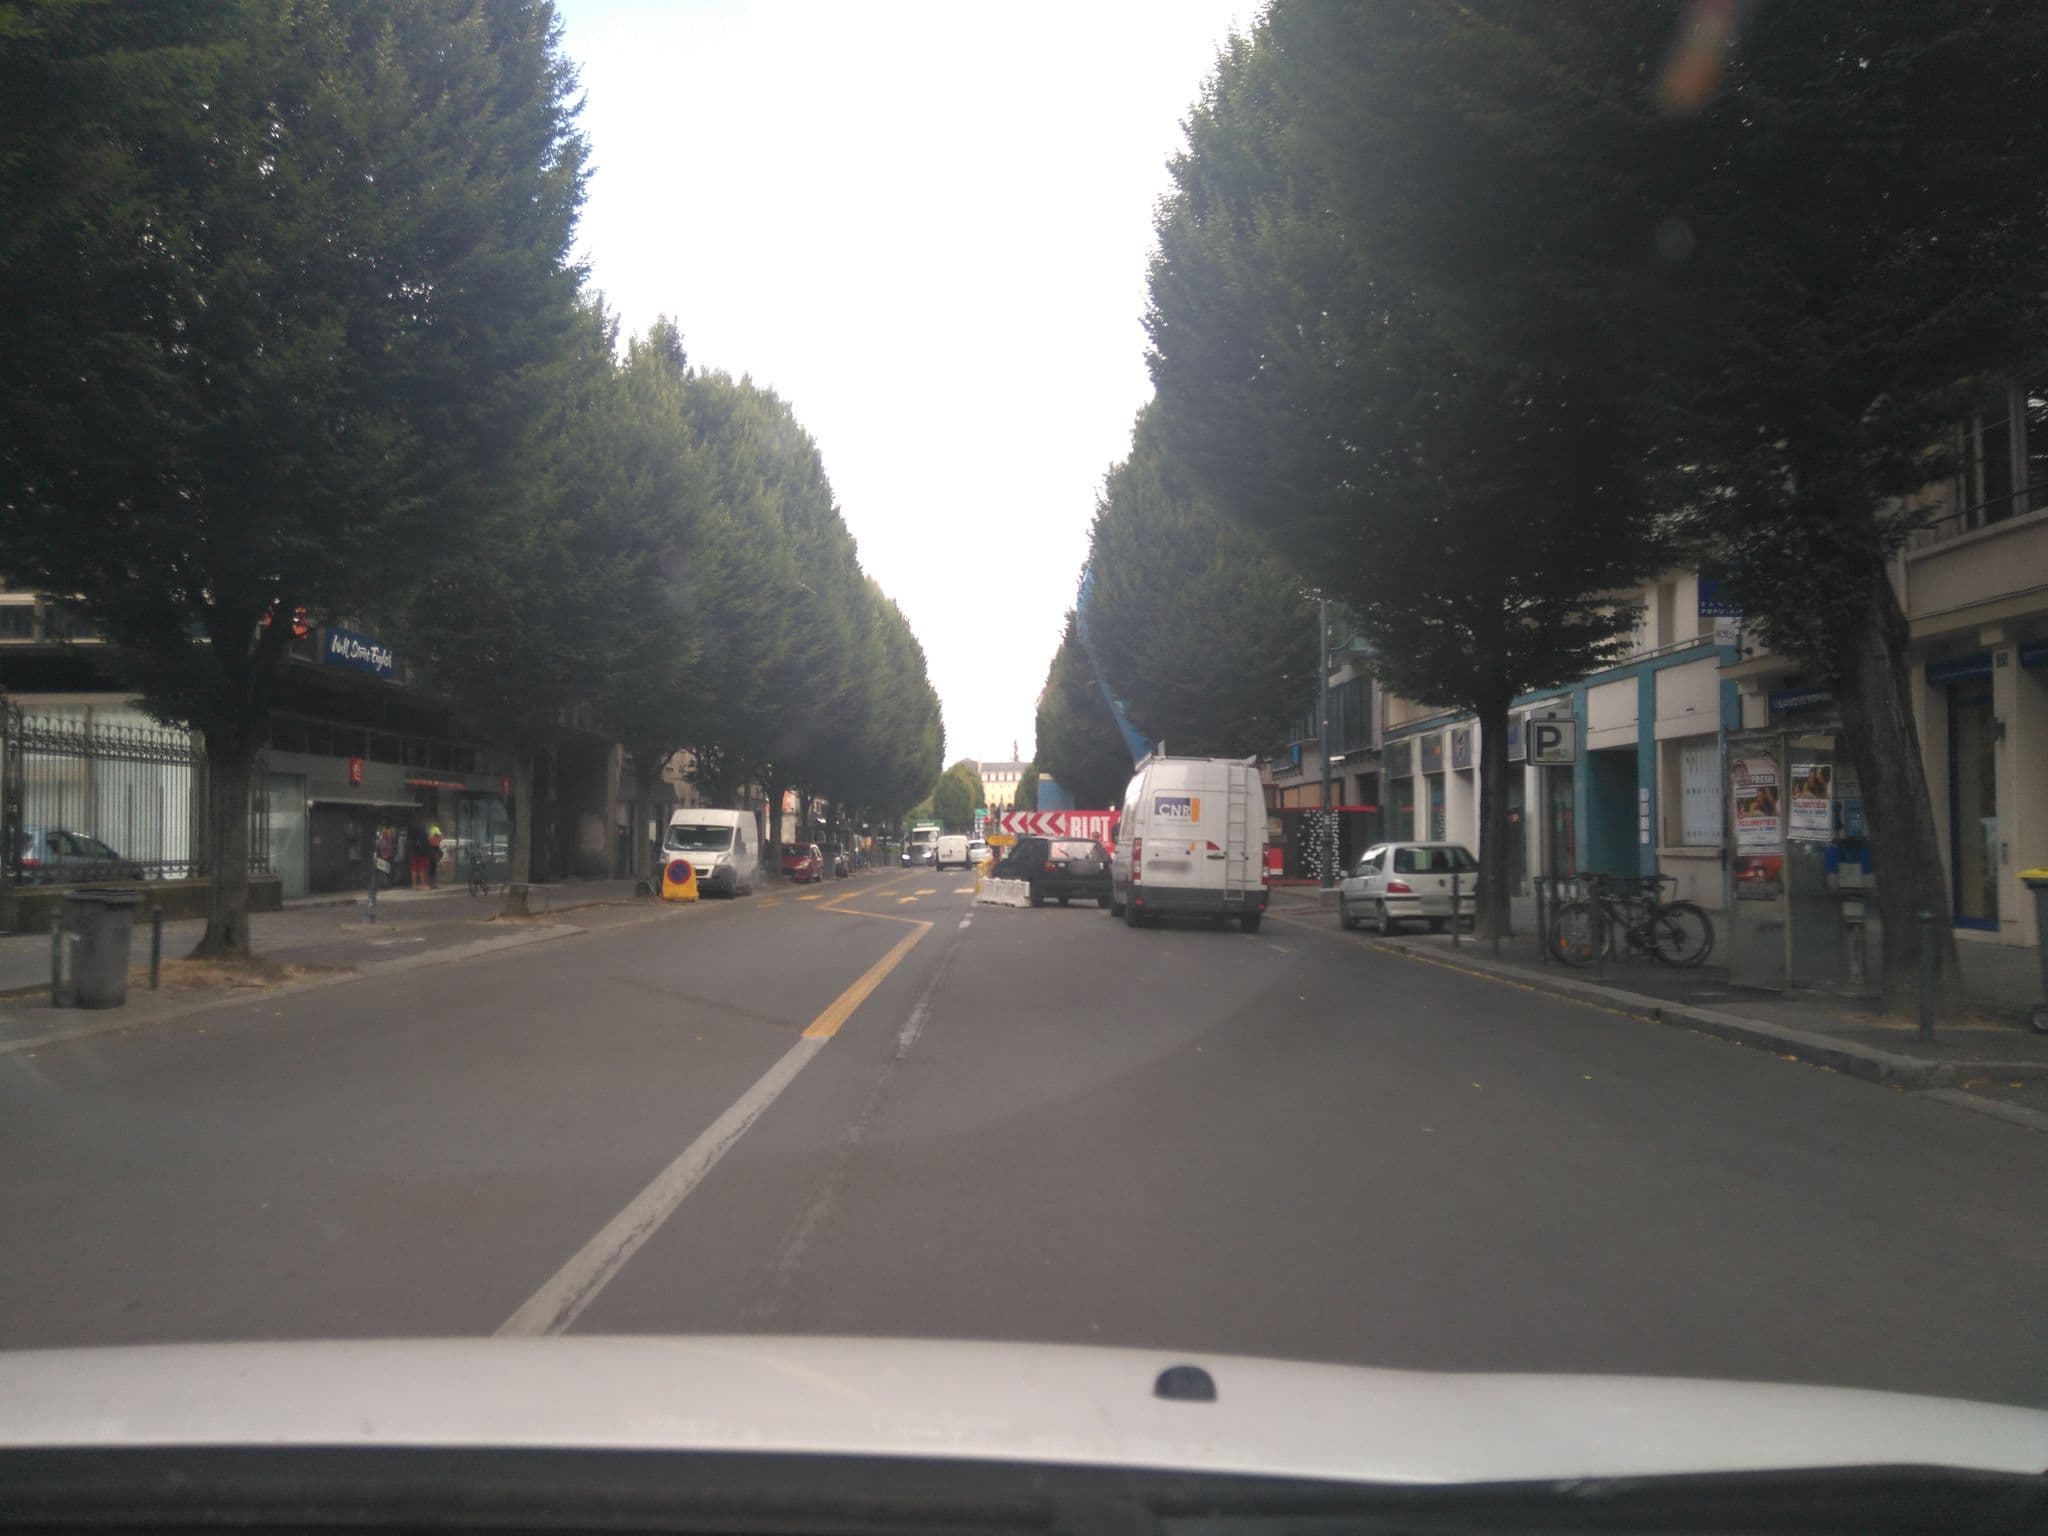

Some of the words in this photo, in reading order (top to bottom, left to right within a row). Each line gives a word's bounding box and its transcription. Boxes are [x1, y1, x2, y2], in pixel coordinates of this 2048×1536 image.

[350, 641, 371, 663] Street
[1536, 725, 1562, 758] P
[1158, 803, 1191, 817] CNR
